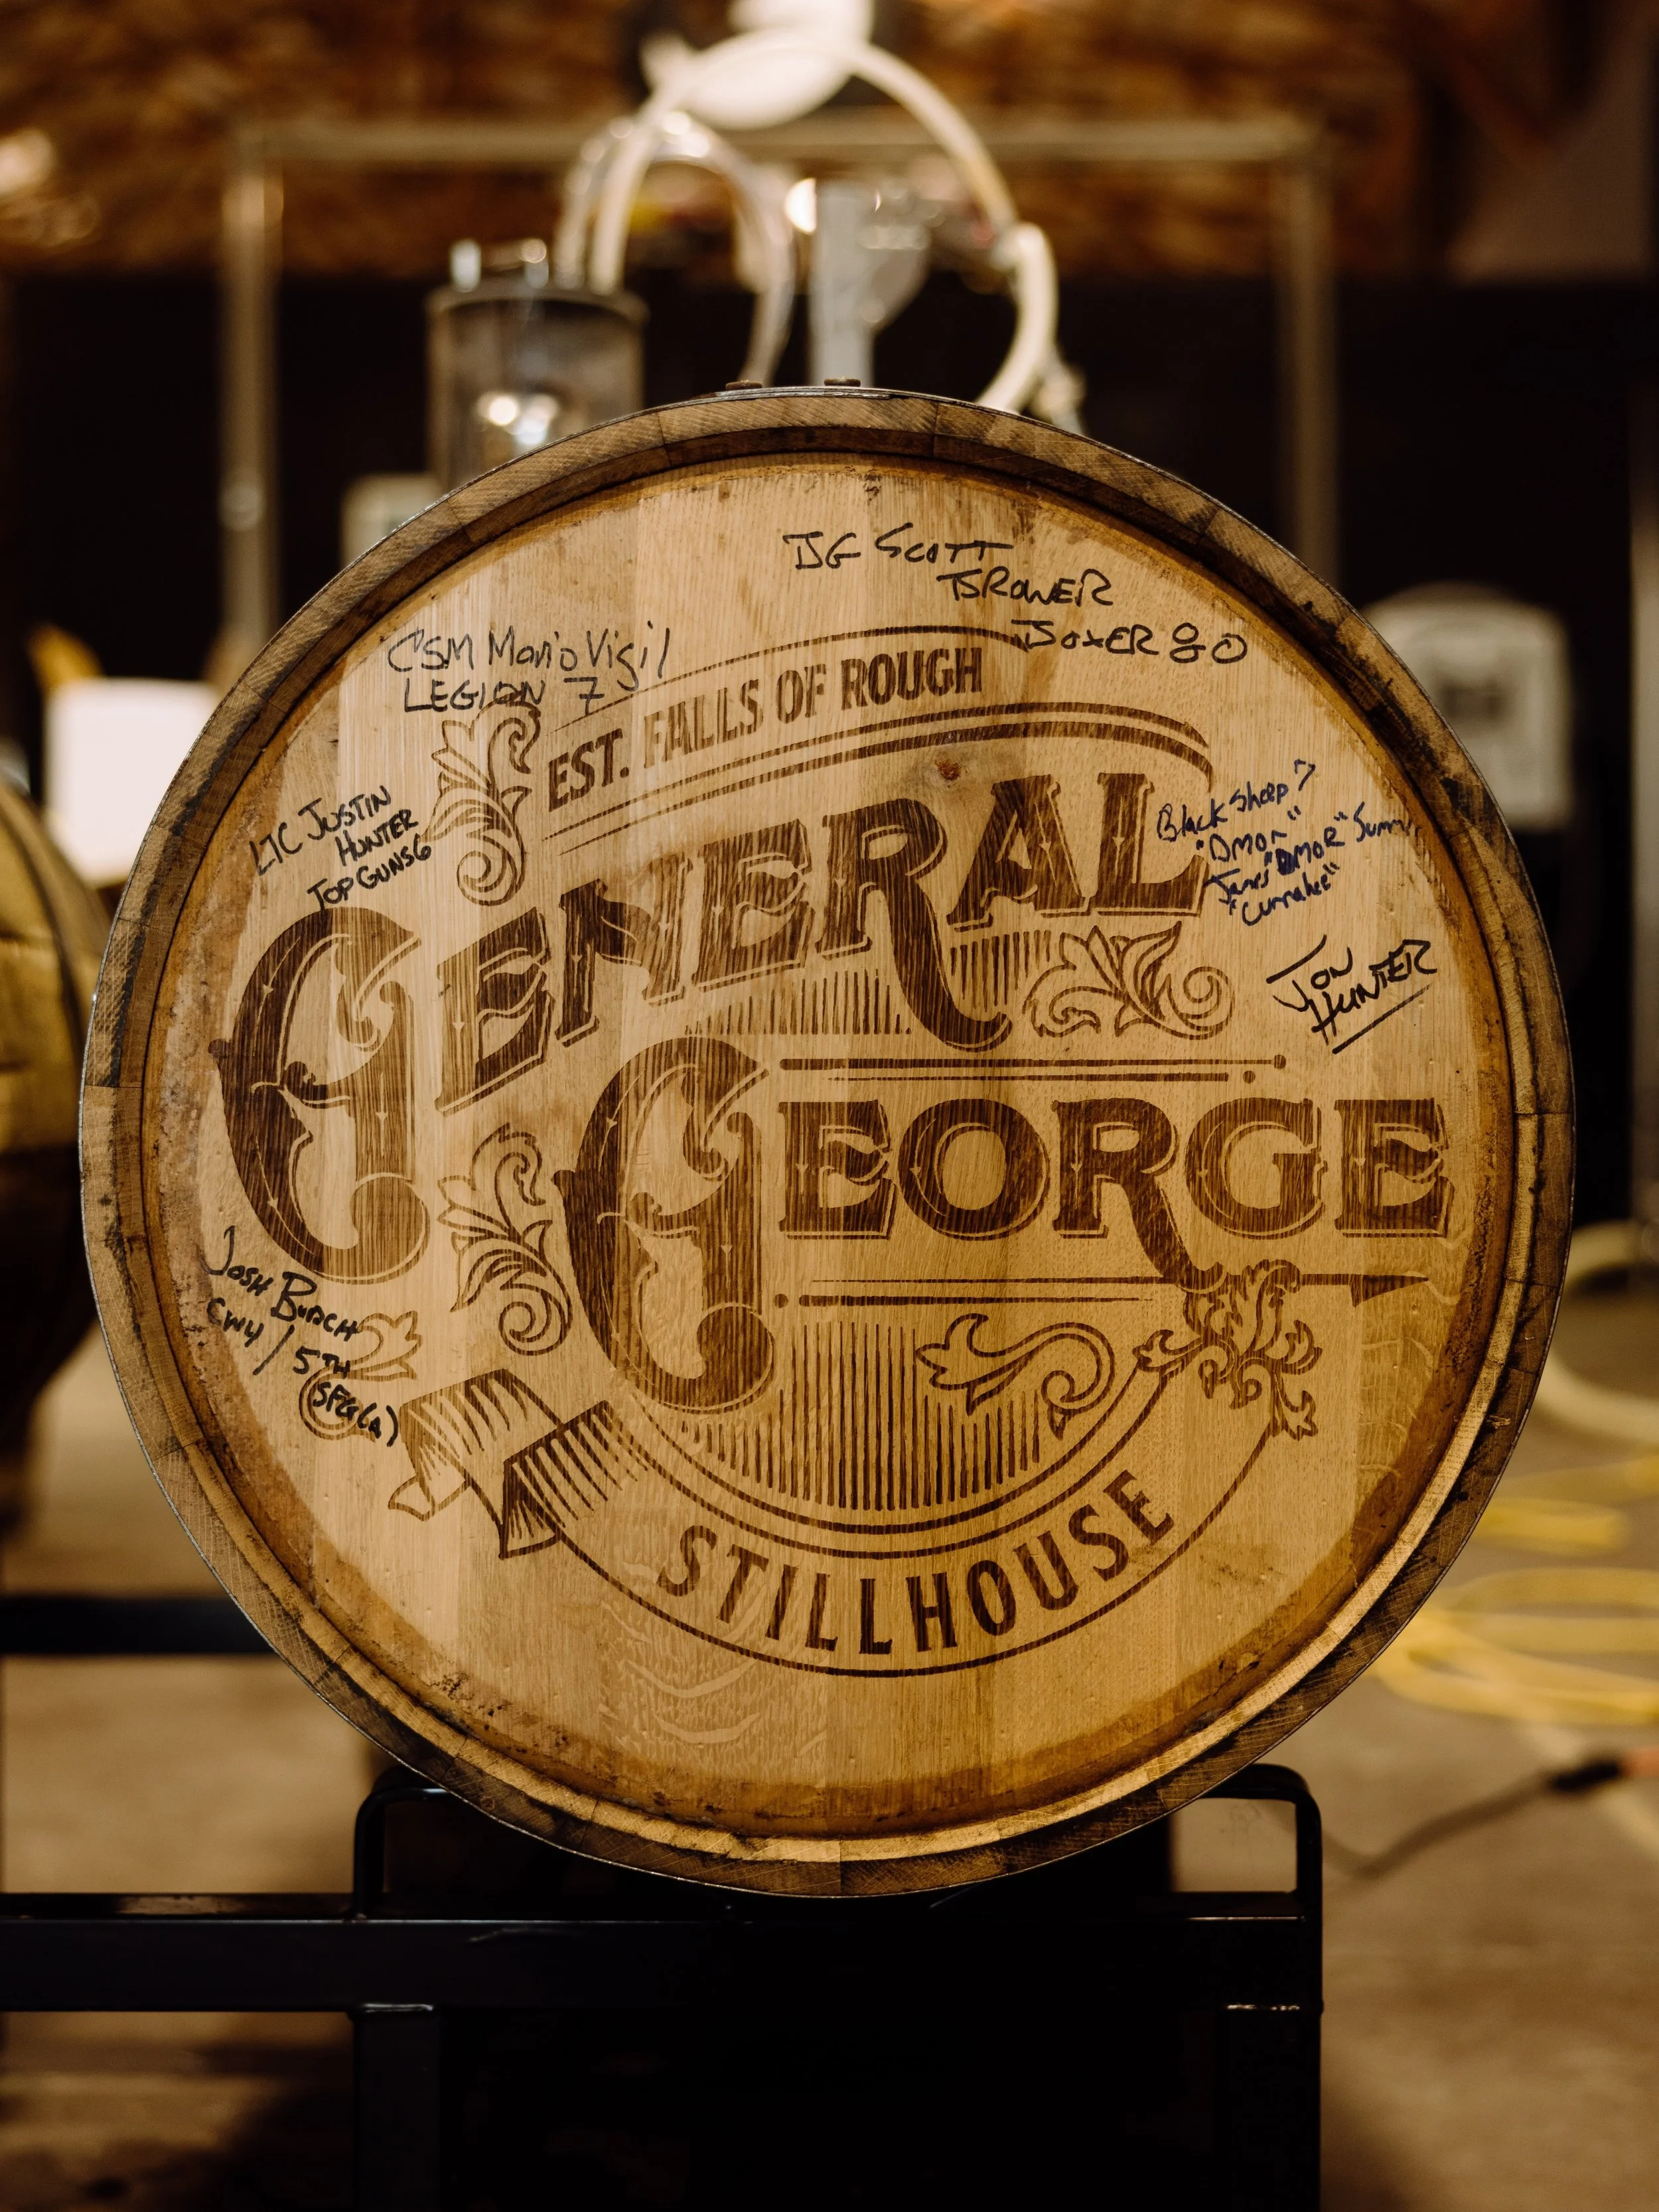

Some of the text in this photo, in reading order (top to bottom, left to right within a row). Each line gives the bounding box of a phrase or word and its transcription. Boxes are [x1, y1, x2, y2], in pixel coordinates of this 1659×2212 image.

[874, 522, 1015, 563] SCOTT
[387, 620, 670, 692] CSM Mario Vigil
[404, 676, 605, 715] LEGION 7
[547, 646, 983, 812] EST. FALLS OF ROUGH
[249, 784, 391, 876] LTC JUSTIN
[334, 809, 419, 867] HUNTER
[208, 773, 1210, 1286] GENERAL
[552, 1037, 1455, 1414] GEORGE
[656, 1469, 1175, 1656] STILLHOUSE
